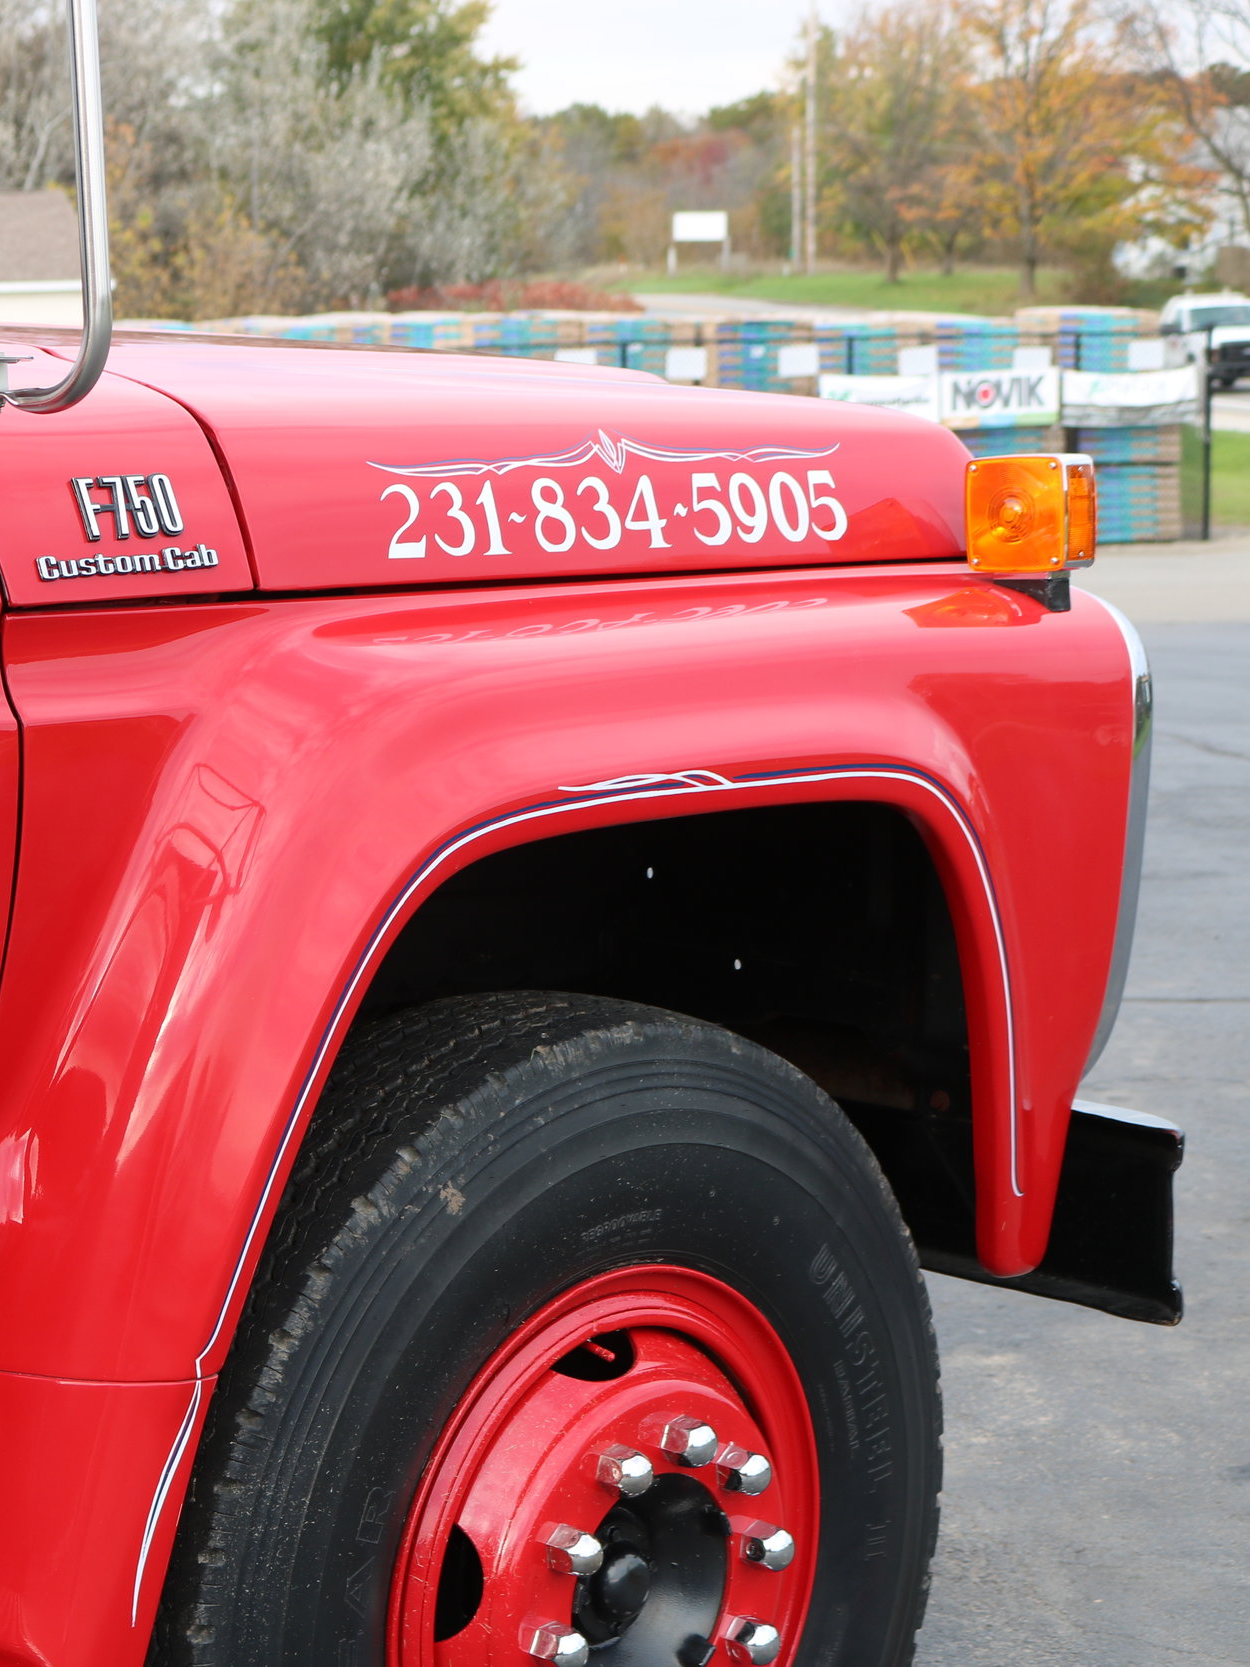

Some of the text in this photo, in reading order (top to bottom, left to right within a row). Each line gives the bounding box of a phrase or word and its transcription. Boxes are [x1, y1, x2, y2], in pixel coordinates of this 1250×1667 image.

[951, 375, 1045, 411] NOVIK
[36, 544, 220, 582] Custom Cab
